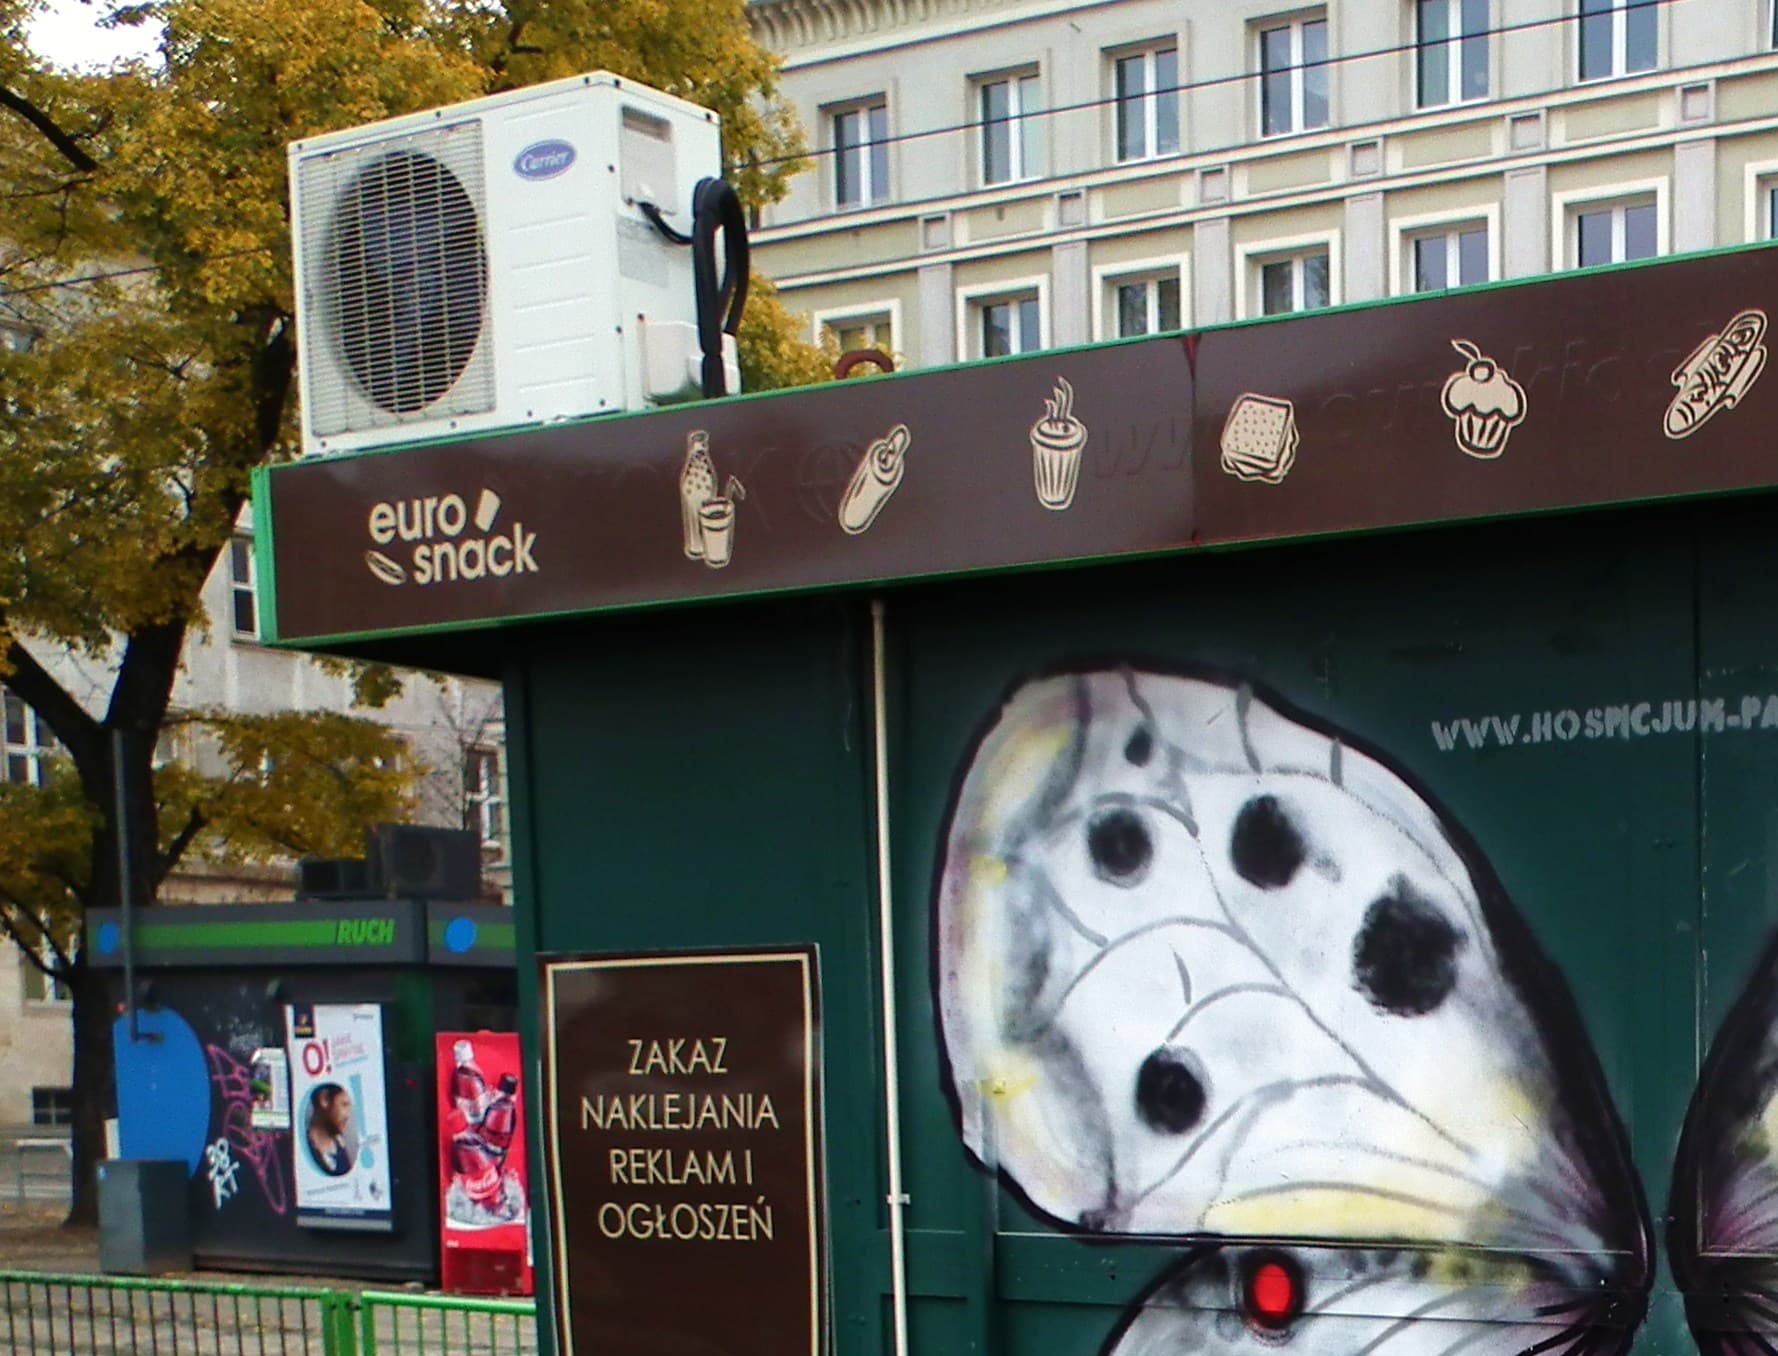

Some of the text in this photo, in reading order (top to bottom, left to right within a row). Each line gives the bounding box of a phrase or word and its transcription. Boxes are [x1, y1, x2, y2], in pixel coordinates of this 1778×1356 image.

[369, 494, 466, 544] euro
[413, 523, 539, 584] snack
[337, 918, 396, 946] RUCH
[302, 1039, 332, 1078] O!
[627, 1037, 728, 1075] ZAKAZ
[581, 1093, 780, 1130] NAKLEJANIA
[609, 1148, 753, 1185] REKLAM I
[598, 1195, 774, 1240] OGŁOSZEŃ
